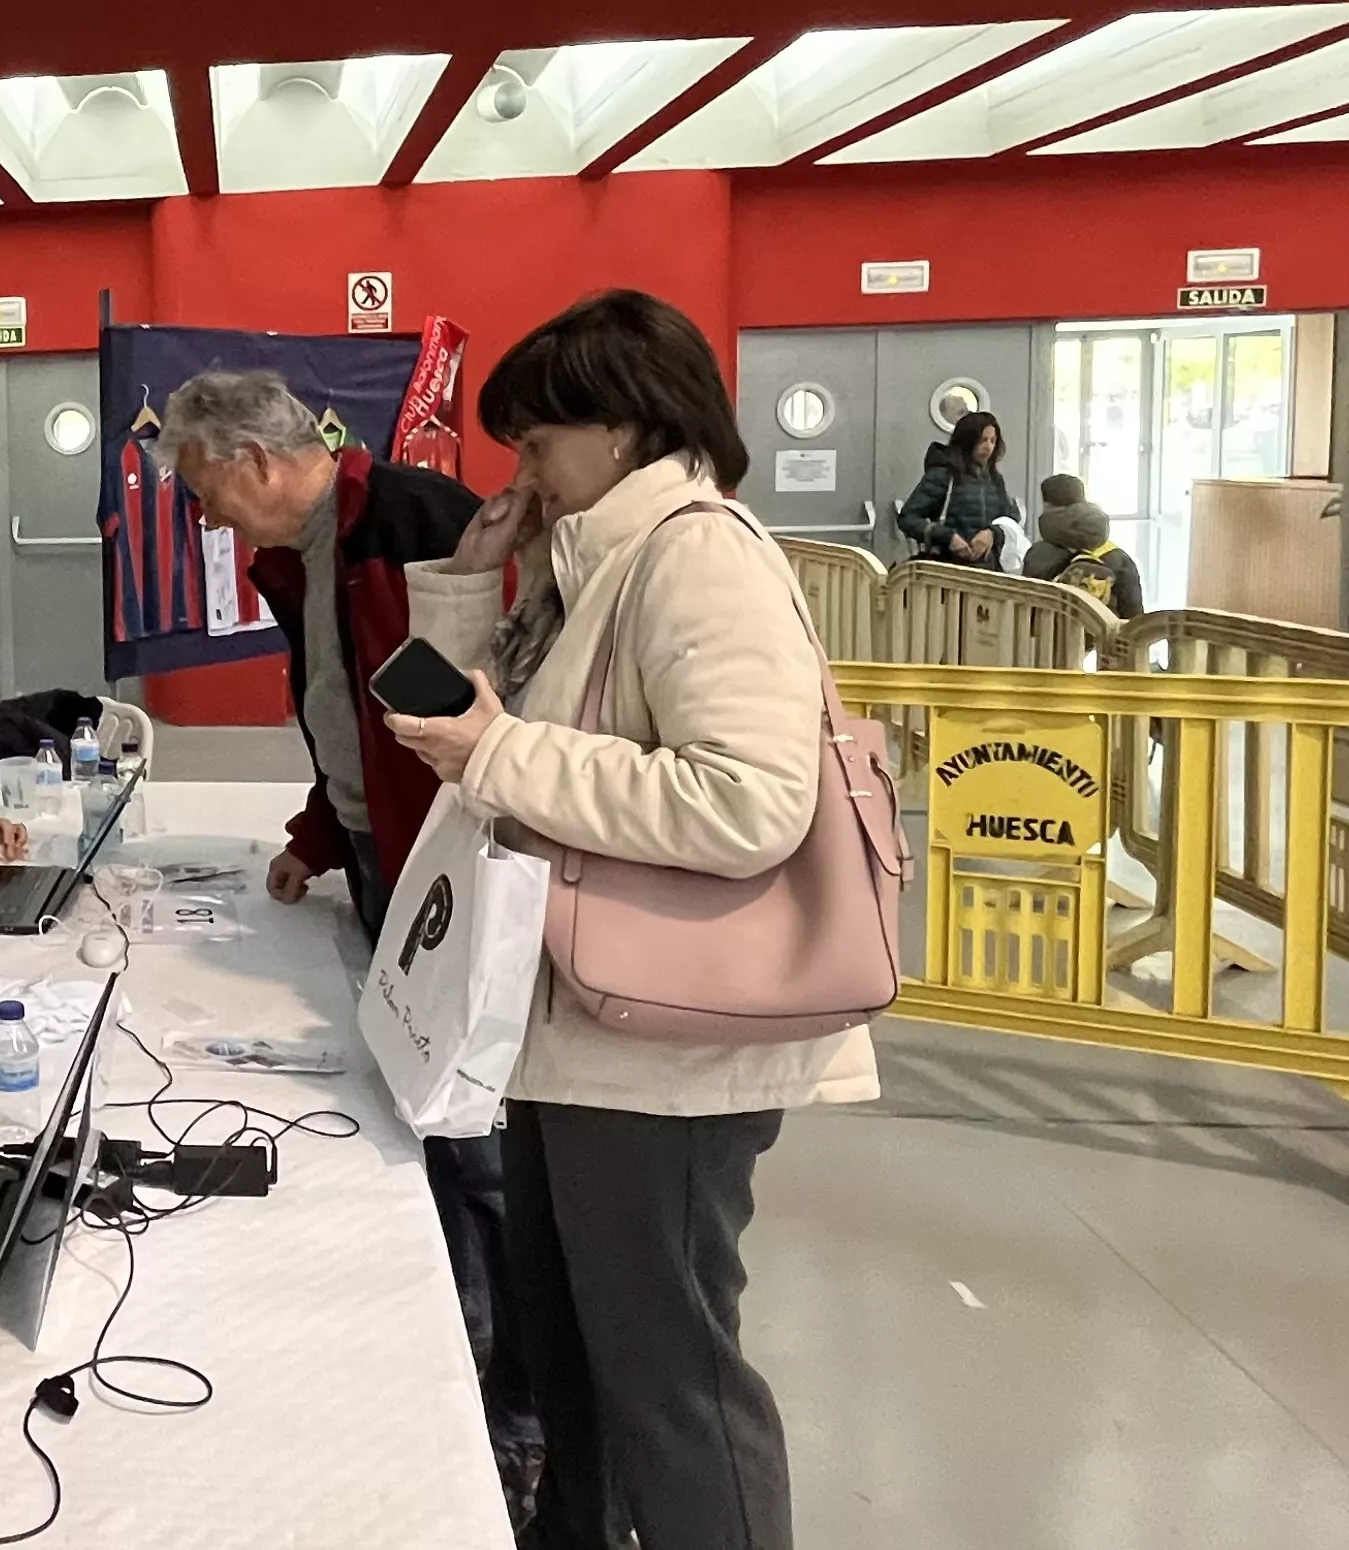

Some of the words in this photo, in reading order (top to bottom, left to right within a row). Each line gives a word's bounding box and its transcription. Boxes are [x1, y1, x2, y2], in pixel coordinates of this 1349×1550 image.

[1188, 289, 1255, 305] SALIDA
[416, 347, 448, 418] Huesca
[935, 741, 1099, 798] AYUNTAMIENTO
[965, 813, 1076, 846] HUESCA
[175, 908, 215, 924] 18
